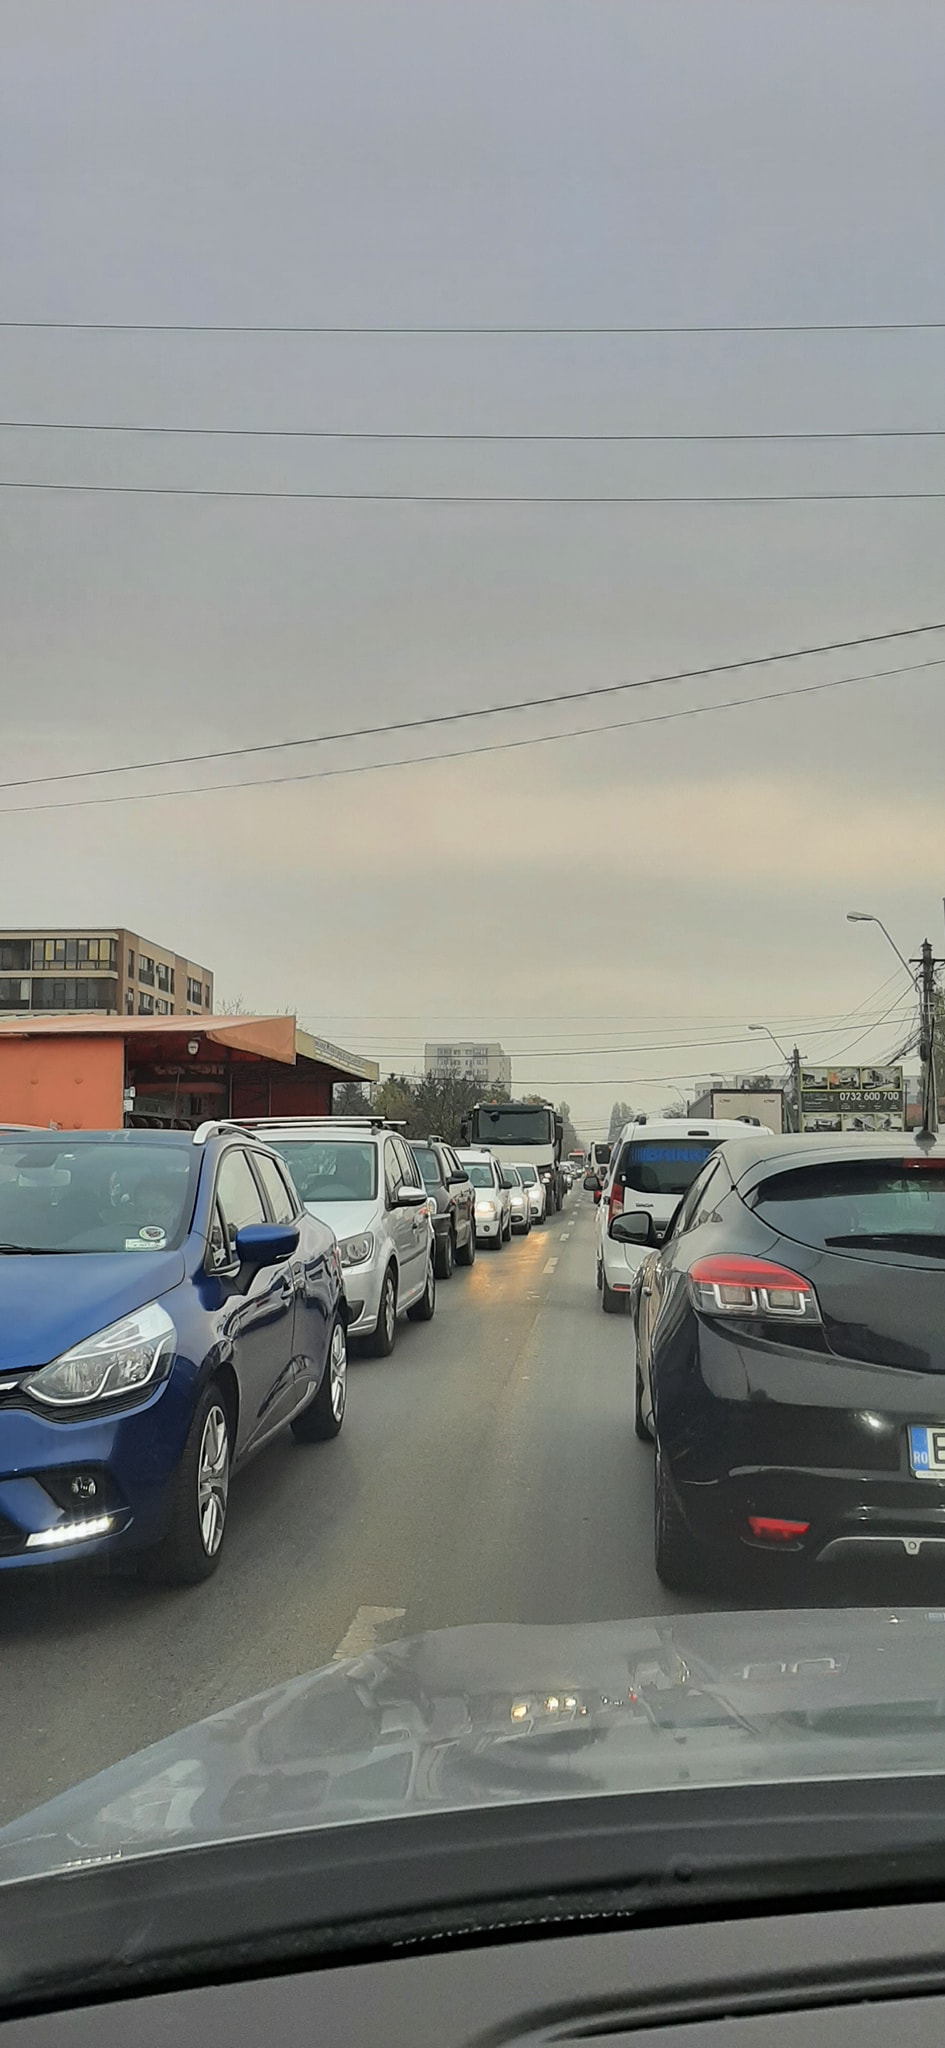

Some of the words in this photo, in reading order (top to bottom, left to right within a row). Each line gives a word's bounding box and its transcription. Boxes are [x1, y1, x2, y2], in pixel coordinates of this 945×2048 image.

[839, 1092, 862, 1101] 0732
[863, 1092, 880, 1101] 600
[882, 1091, 899, 1101] 700
[913, 1450, 928, 1464] RO
